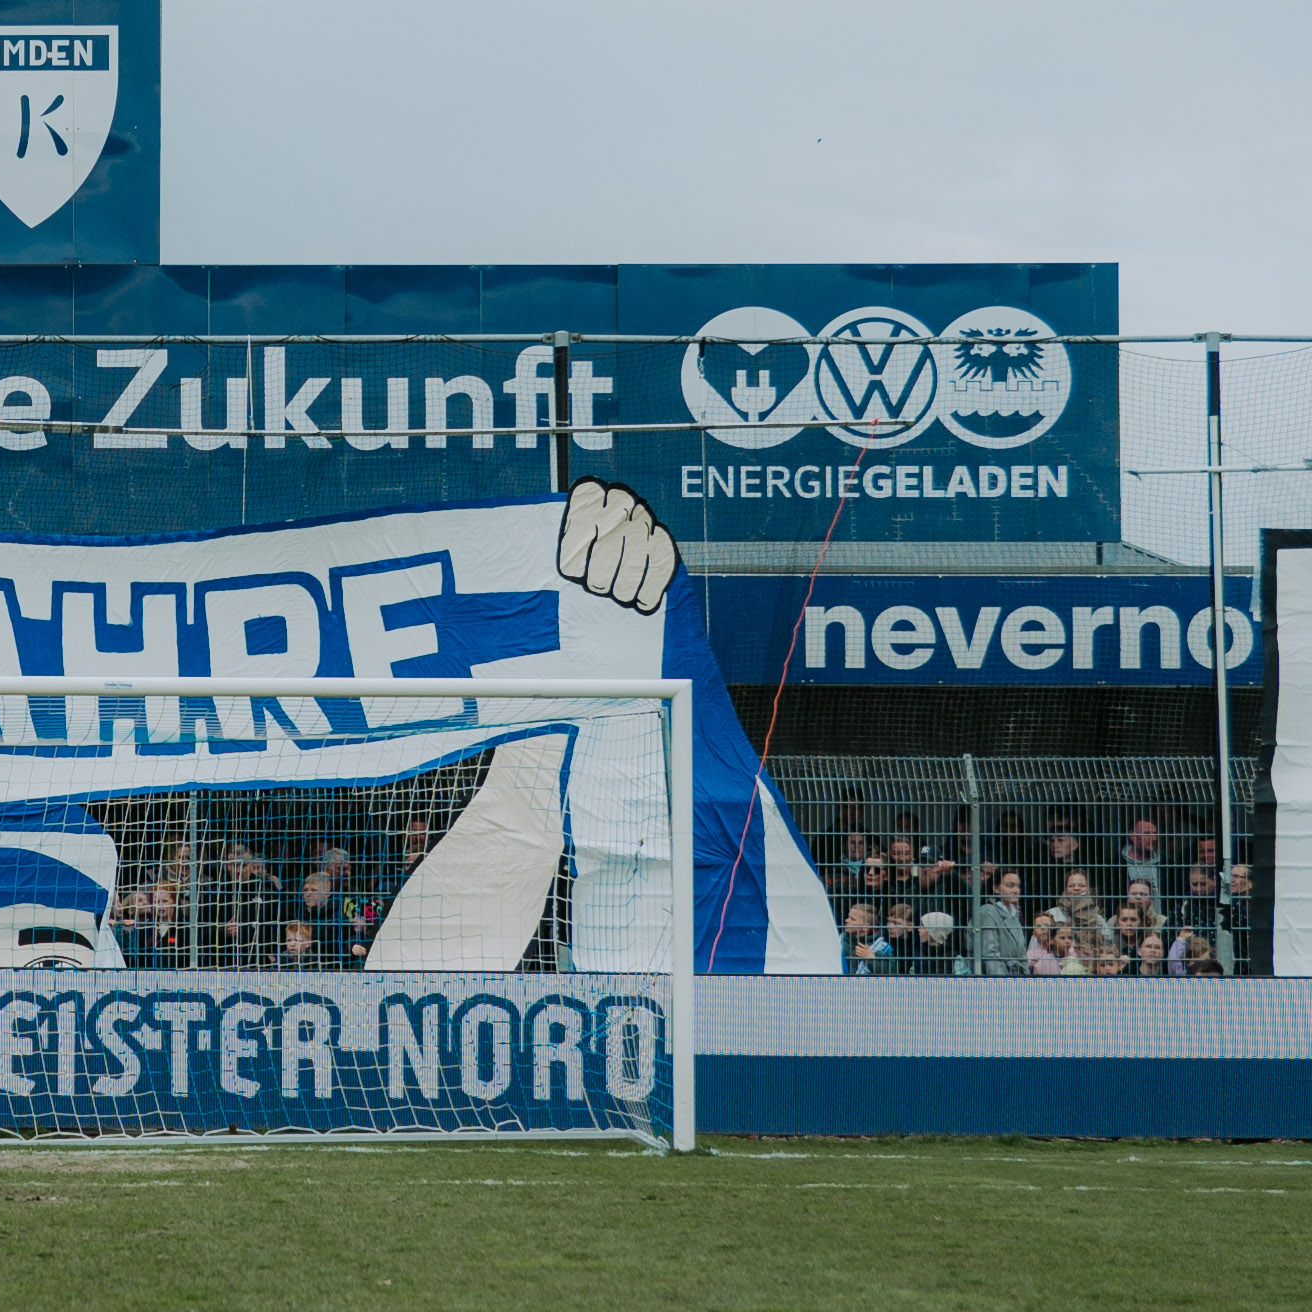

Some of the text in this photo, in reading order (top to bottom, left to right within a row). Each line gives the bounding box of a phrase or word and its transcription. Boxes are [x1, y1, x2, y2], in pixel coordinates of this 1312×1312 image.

[93, 344, 614, 451] Zukunft
[681, 464, 1069, 500] ENERGIEGELADEN
[804, 603, 1254, 671] neverno
[385, 994, 658, 1102] NORD
